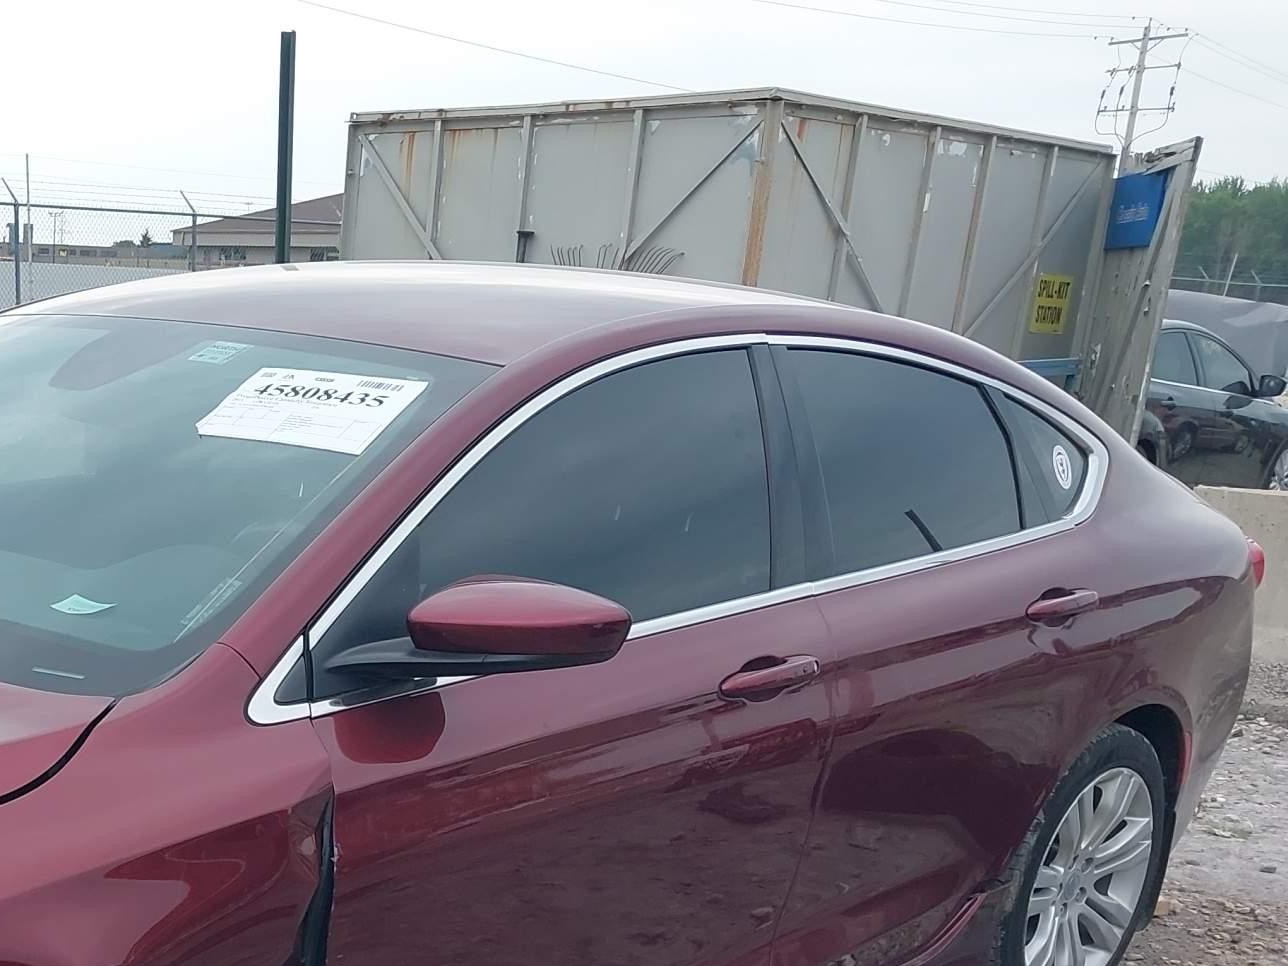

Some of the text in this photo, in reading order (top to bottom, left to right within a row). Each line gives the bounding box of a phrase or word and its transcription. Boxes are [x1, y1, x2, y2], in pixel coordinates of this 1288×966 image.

[1038, 279, 1071, 300] SPILL-KIT
[1035, 304, 1063, 325] STATION
[253, 383, 391, 408] 45808435
